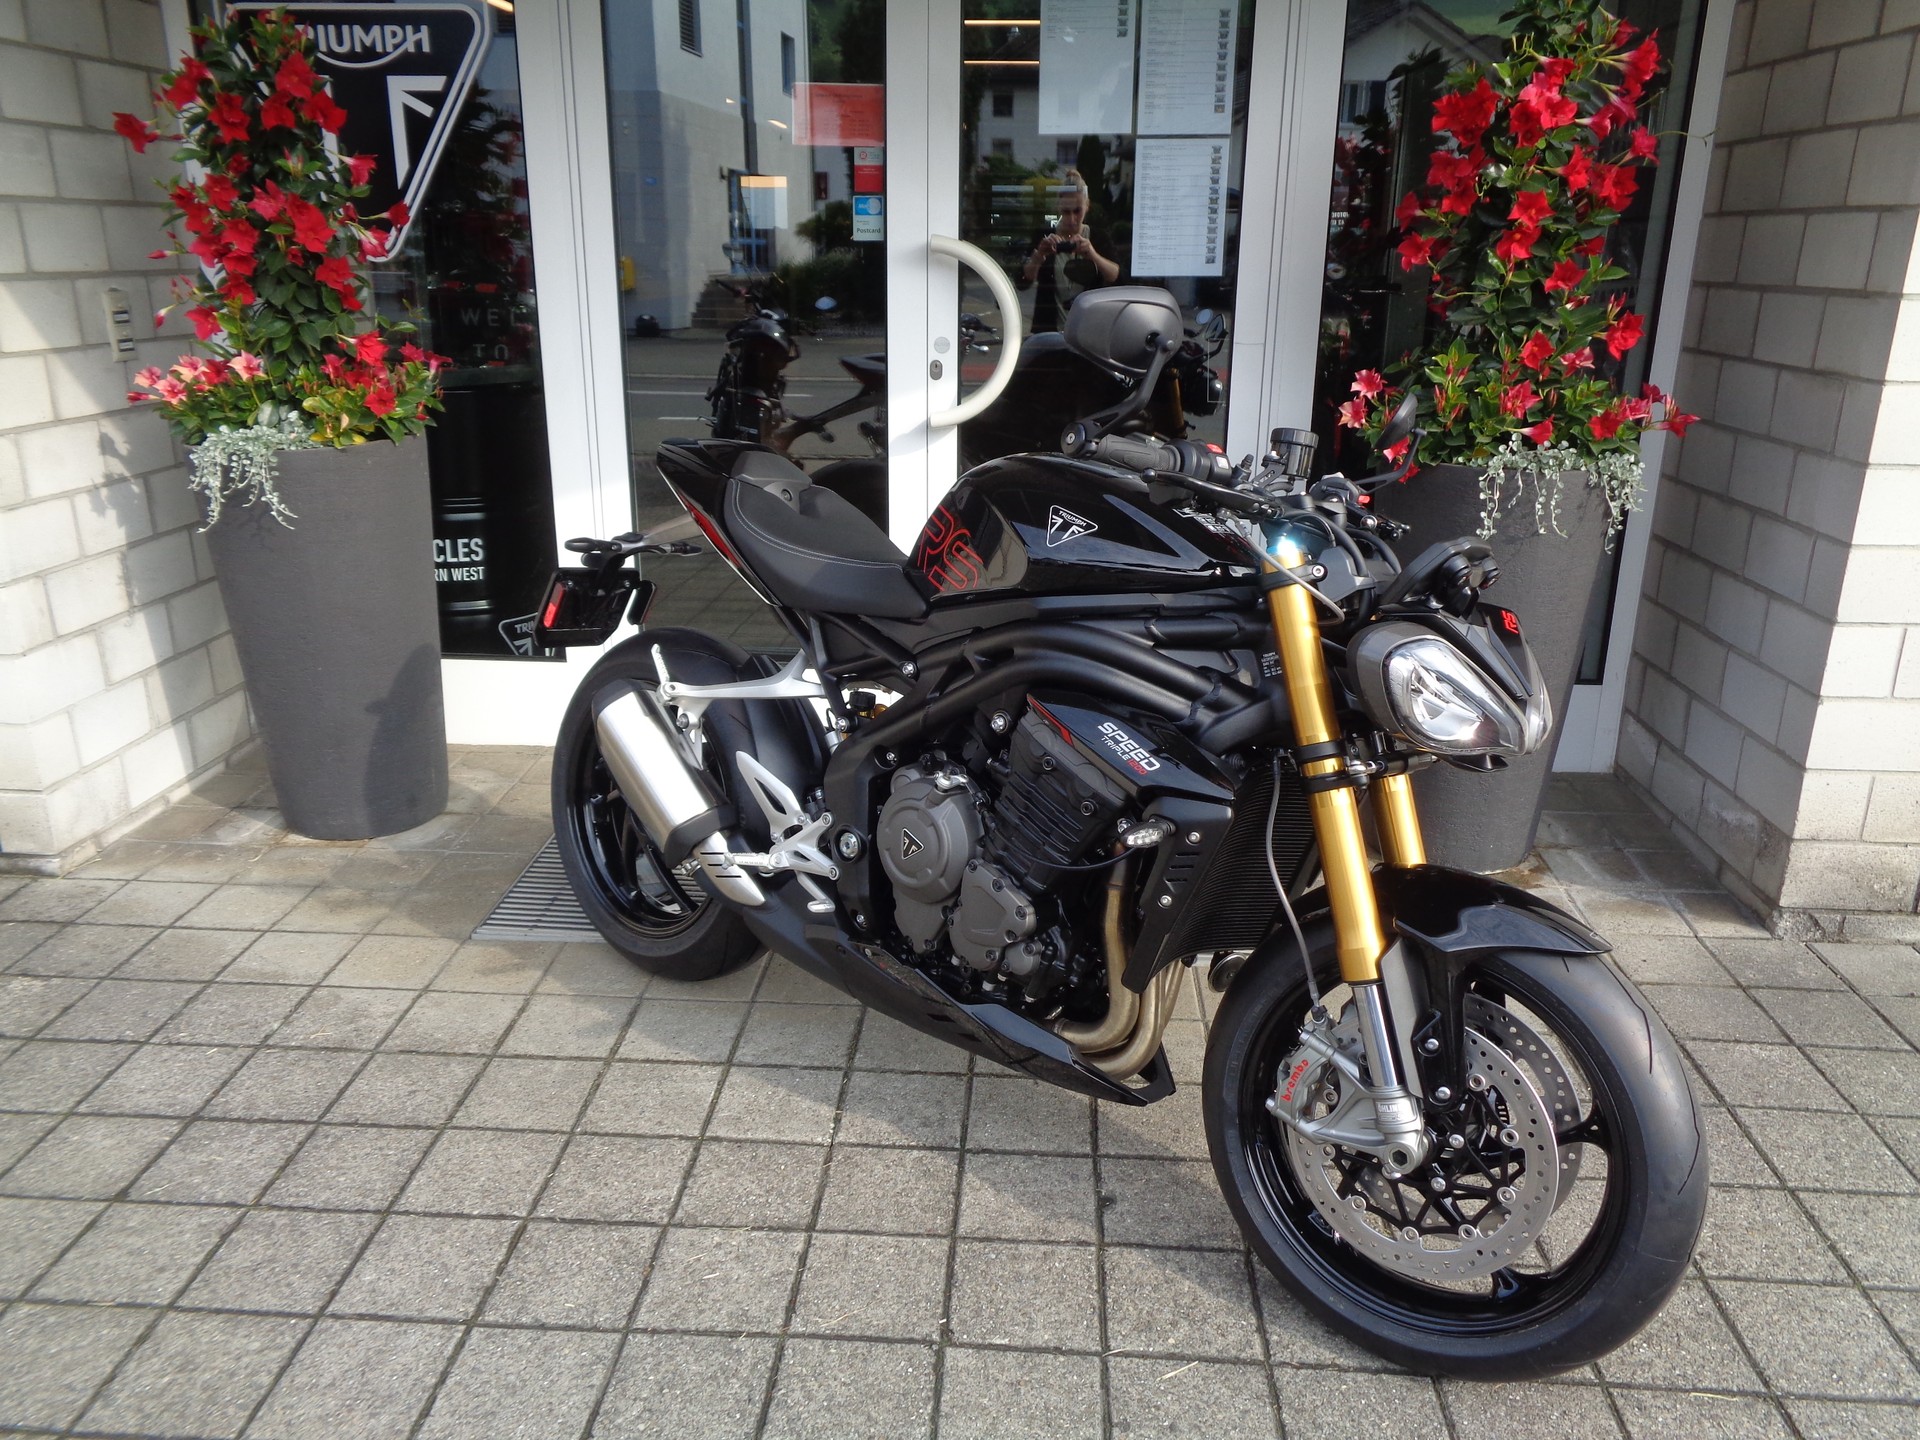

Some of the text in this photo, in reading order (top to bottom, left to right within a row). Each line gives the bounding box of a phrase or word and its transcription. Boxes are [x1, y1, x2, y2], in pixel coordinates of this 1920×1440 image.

[1058, 510, 1087, 527] TRIUMPH
[432, 537, 484, 563] CLES
[450, 566, 485, 581] WEST
[1500, 609, 1520, 635] RS
[1097, 721, 1161, 771] SPEED
[1100, 735, 1149, 776] TRIPLE 1200
[1280, 1058, 1309, 1103] brembo
